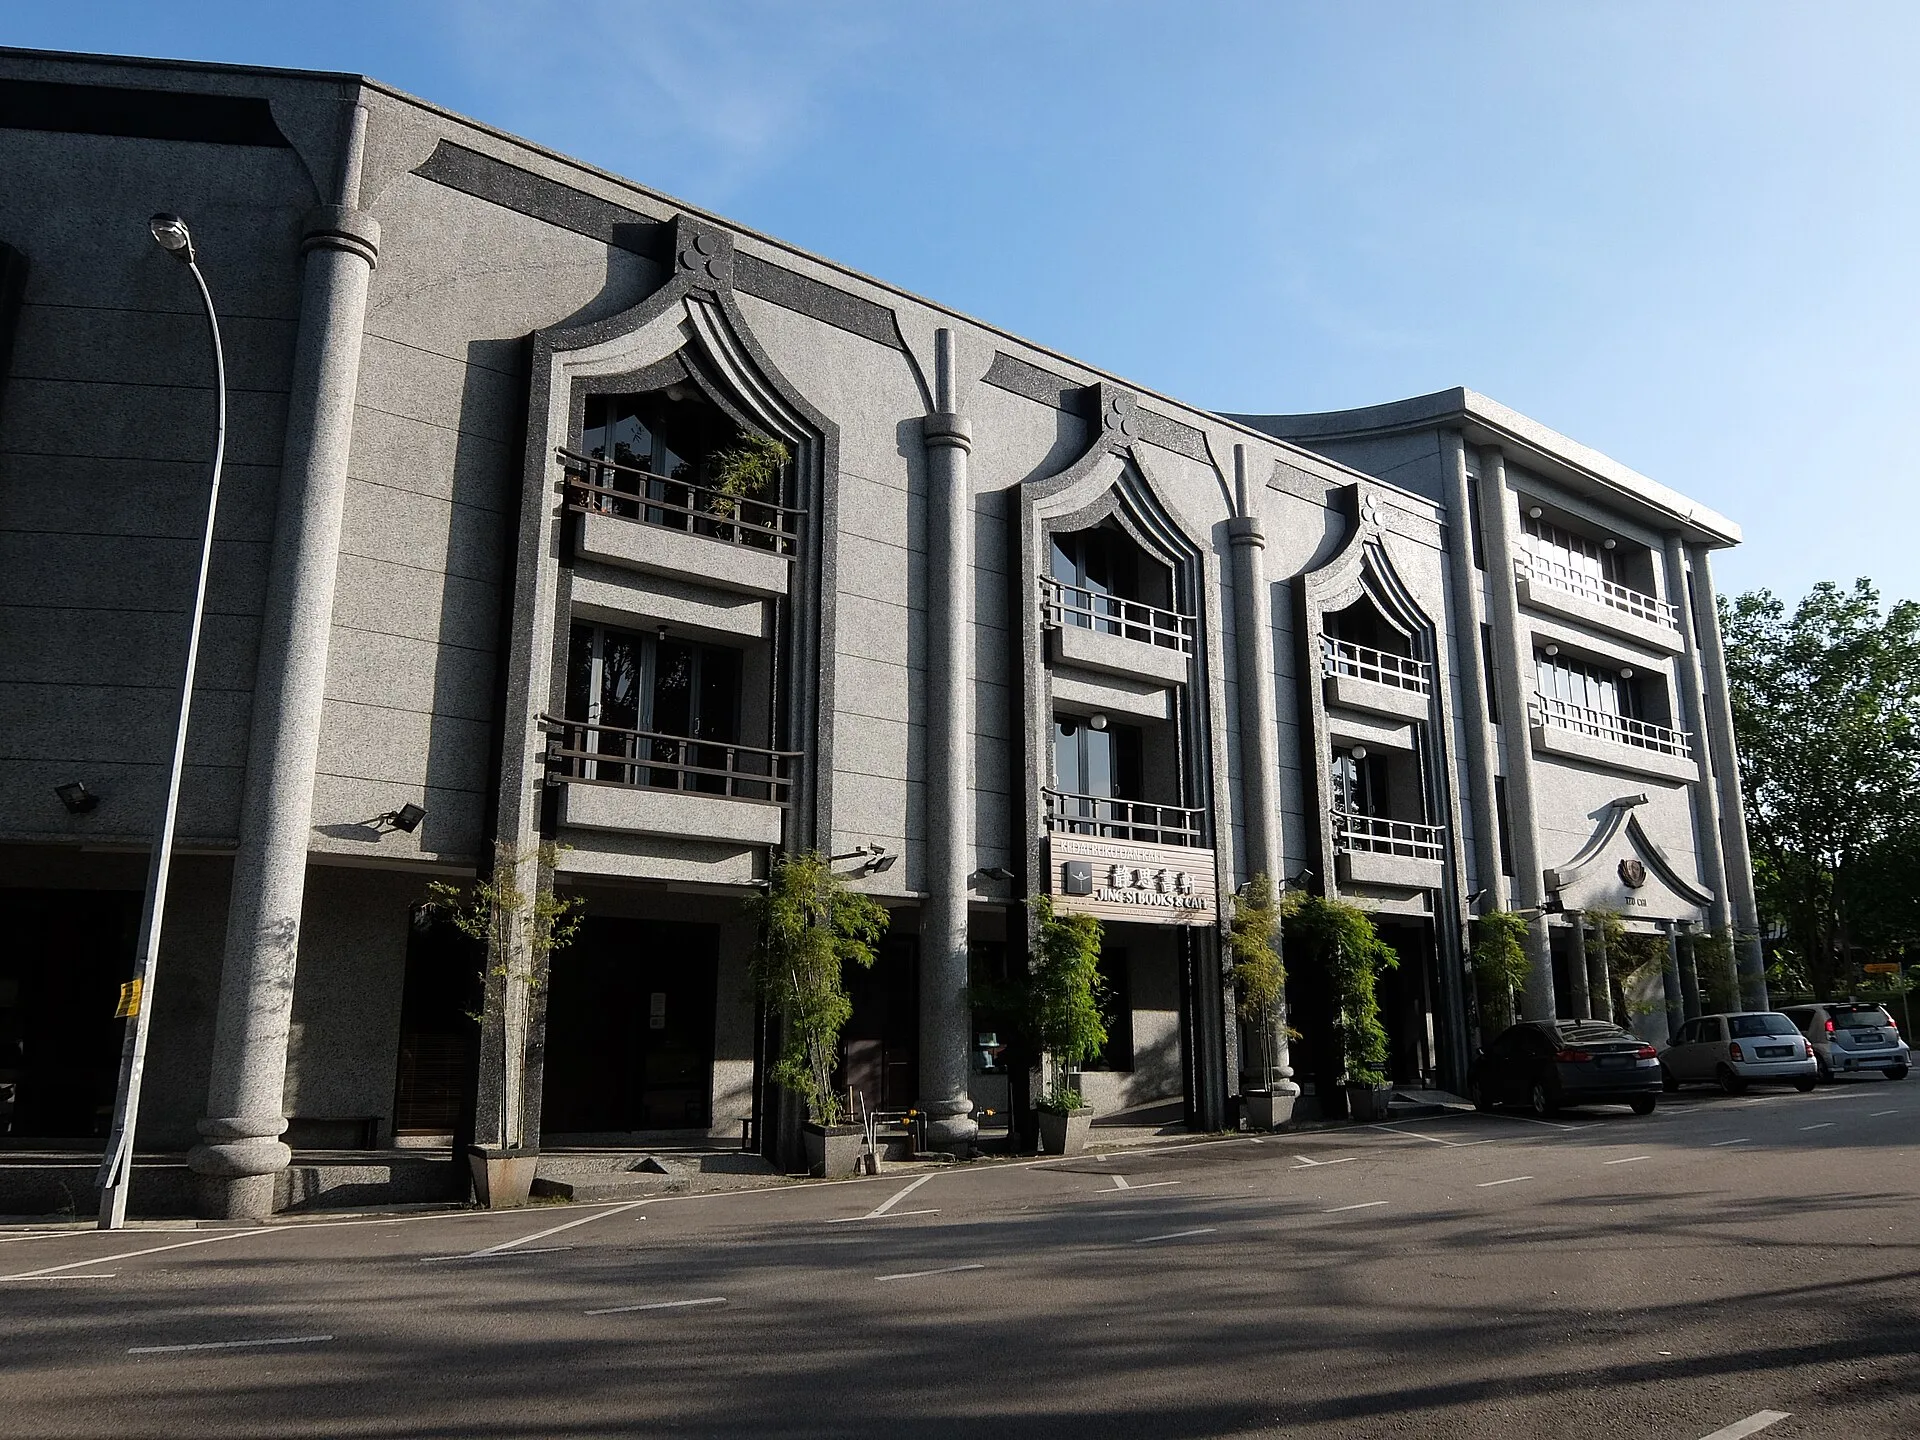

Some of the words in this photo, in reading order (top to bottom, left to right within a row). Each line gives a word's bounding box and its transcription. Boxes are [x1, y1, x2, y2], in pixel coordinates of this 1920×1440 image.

[1092, 844, 1118, 857] BUKU
[1120, 847, 1140, 860] DAN
[1139, 892, 1174, 906] BOOKS
[1175, 895, 1183, 907] &
